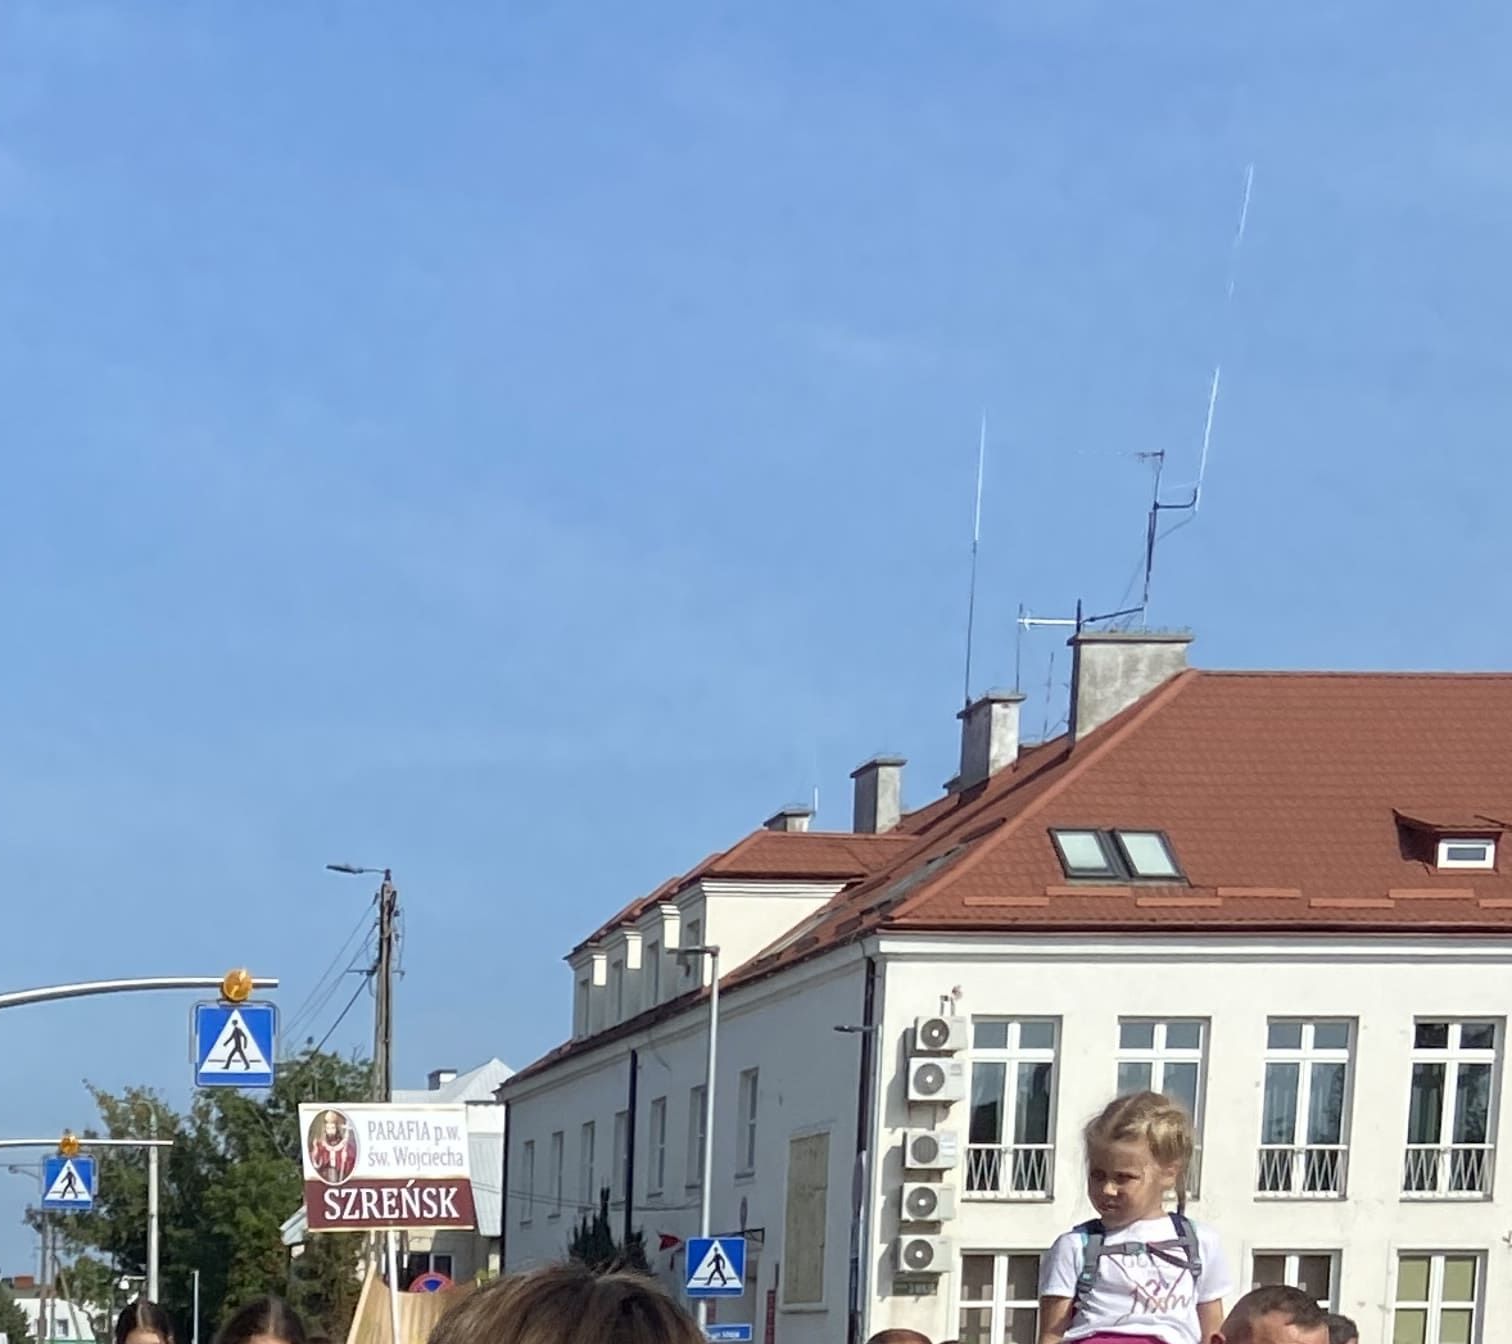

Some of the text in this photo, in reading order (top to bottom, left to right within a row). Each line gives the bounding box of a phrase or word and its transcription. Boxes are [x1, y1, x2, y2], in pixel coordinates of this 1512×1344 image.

[368, 1119, 461, 1146] PARAFIA p.w.
[368, 1145, 464, 1171] św. Wojciecha
[324, 1180, 460, 1220] SZREŃSK
